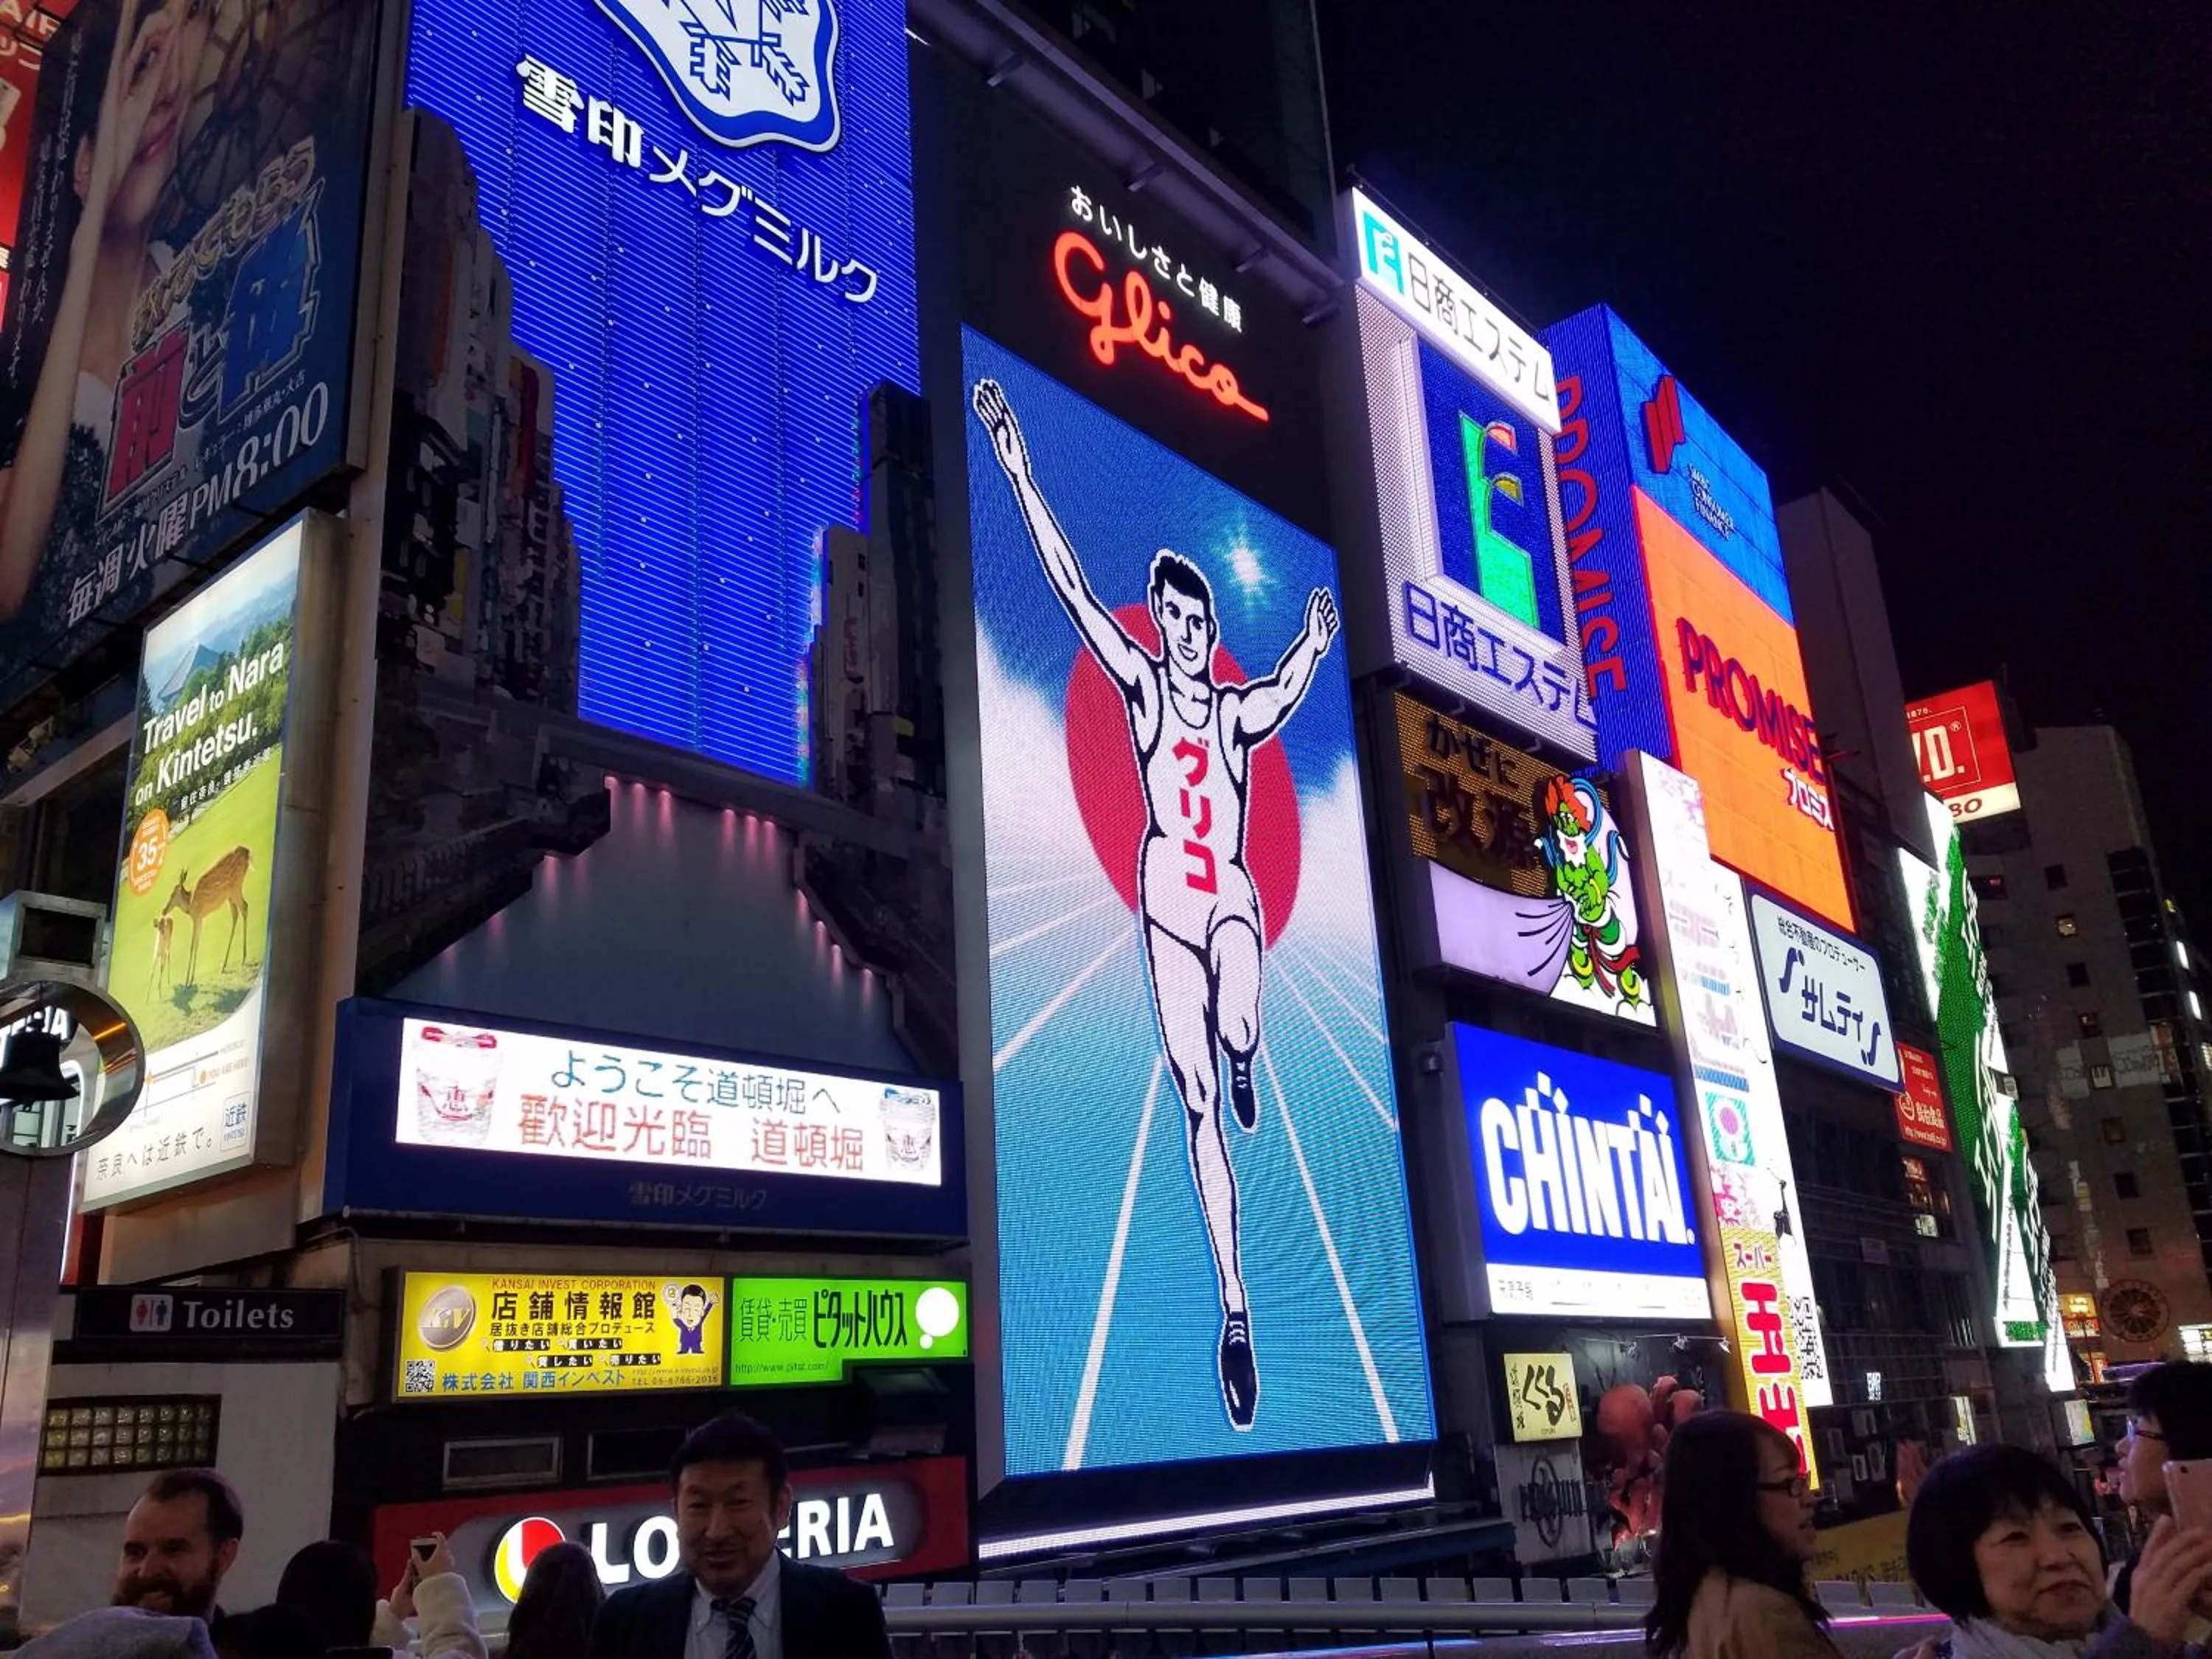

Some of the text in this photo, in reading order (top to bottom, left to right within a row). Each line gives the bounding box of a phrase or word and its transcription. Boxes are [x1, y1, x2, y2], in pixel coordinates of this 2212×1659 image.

[516, 55, 878, 303] 雪印メグミルク
[1071, 184, 1242, 334] おいしさと健康
[1054, 230, 1270, 422] Glico
[143, 642, 284, 754] Travel to Nara
[1676, 616, 1827, 786] PROMISE
[136, 782, 153, 807] on
[156, 712, 258, 794] Kintetsu.
[1172, 736, 1217, 895] グリコ
[1781, 767, 1836, 832] プロミス
[1801, 975, 1863, 1043] サムティ
[551, 1049, 841, 1116] ようこそ道頓堀へ
[223, 1102, 248, 1127] 近鉄
[97, 1127, 212, 1180] 奈良へは近鉄で。
[751, 1116, 863, 1172] 道頓堀
[628, 1180, 768, 1211] 雪印メグミルク
[1733, 1242, 1773, 1270] スーパー
[490, 1290, 656, 1321] 店舗情報館
[492, 1279, 656, 1290] KANSAI INVEST CORPORATION
[183, 1300, 294, 1329] Toilets
[490, 1322, 655, 1338] 居抜き店舗総合プロデュース
[739, 1288, 908, 1349] 賃貸・売買 ピタットハウス
[493, 1338, 623, 1352] 借りたい 買いたい
[536, 1354, 661, 1368] 貸したい 売りたい
[442, 1369, 626, 1392] 株式会社 関西インベスト
[631, 1377, 649, 1386] TEL
[590, 1492, 894, 1585] LORIA
